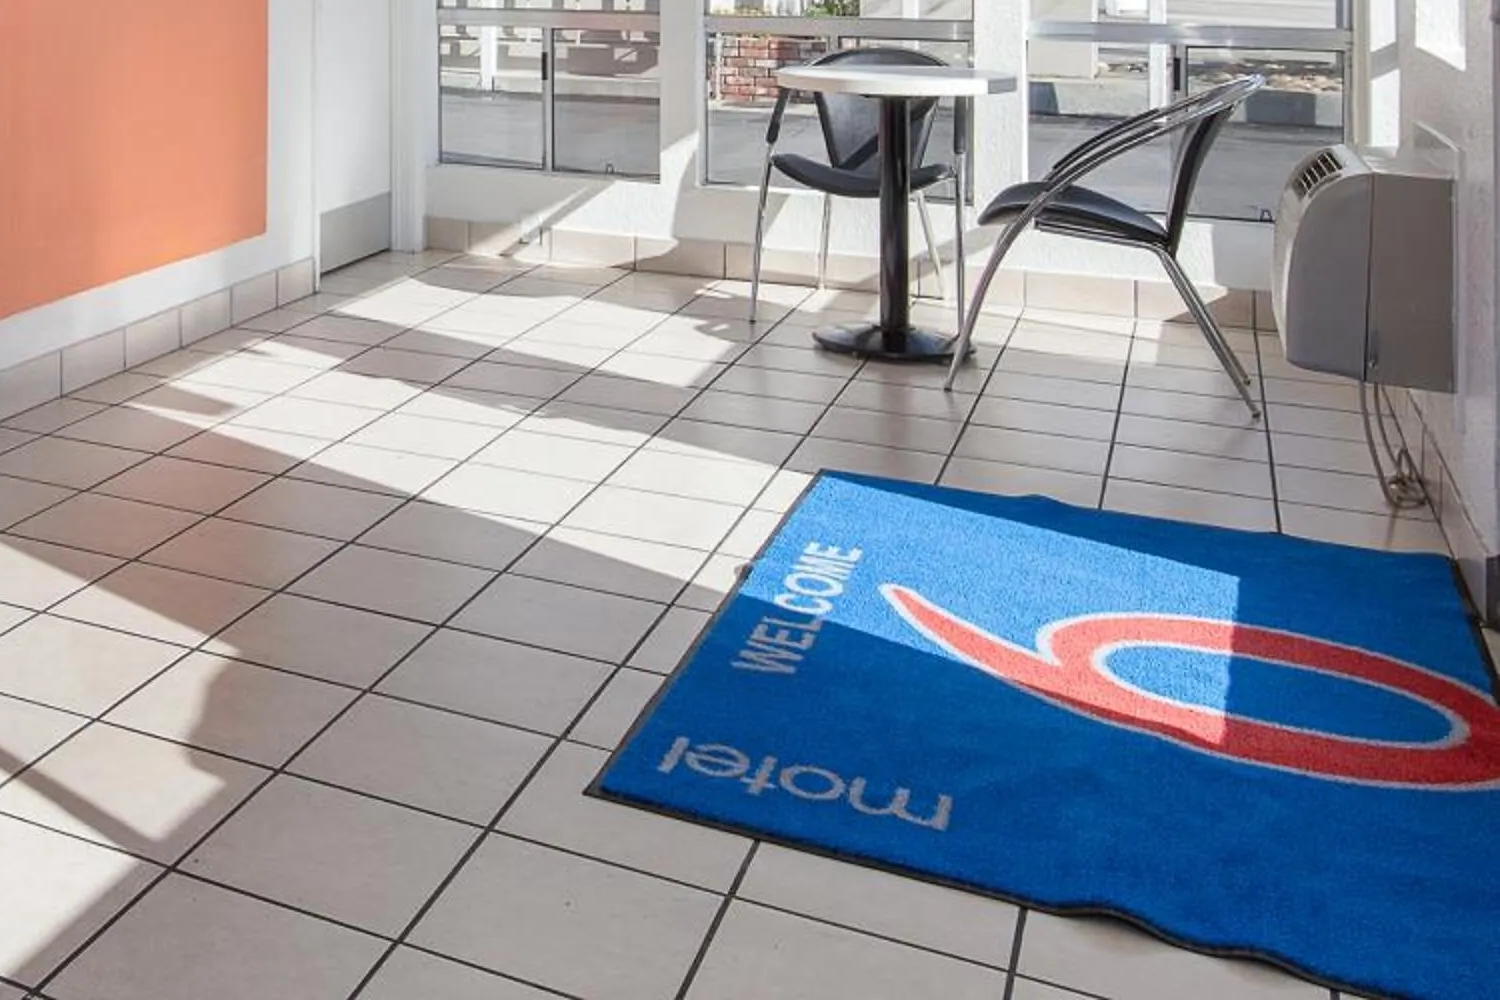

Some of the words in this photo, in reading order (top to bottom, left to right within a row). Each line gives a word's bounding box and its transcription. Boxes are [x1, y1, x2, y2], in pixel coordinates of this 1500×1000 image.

[730, 541, 863, 674] WELCOME
[657, 736, 953, 831] motel
[878, 583, 1500, 791] 6
